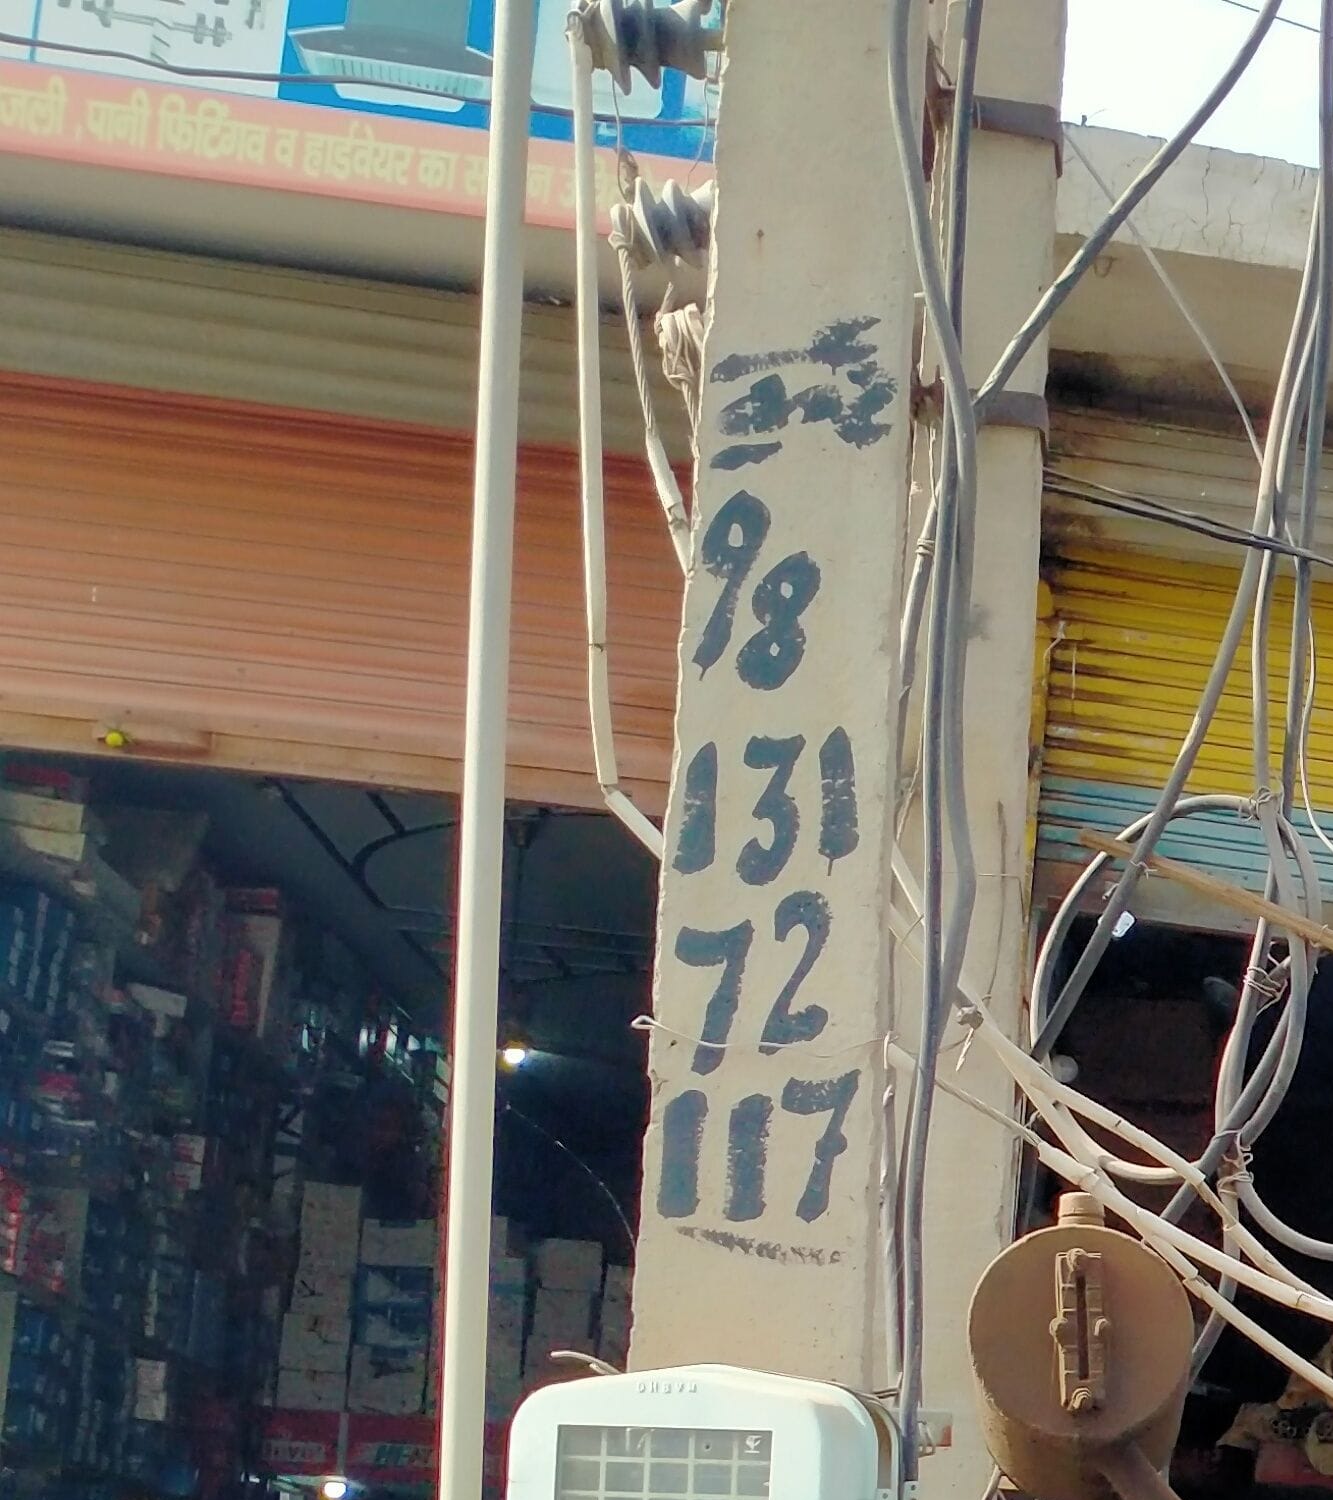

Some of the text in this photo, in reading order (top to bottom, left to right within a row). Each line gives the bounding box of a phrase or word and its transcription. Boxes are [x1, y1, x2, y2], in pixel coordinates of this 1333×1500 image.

[672, 726, 859, 885] 131
[675, 890, 833, 1076] 72
[657, 1069, 860, 1223] 117
